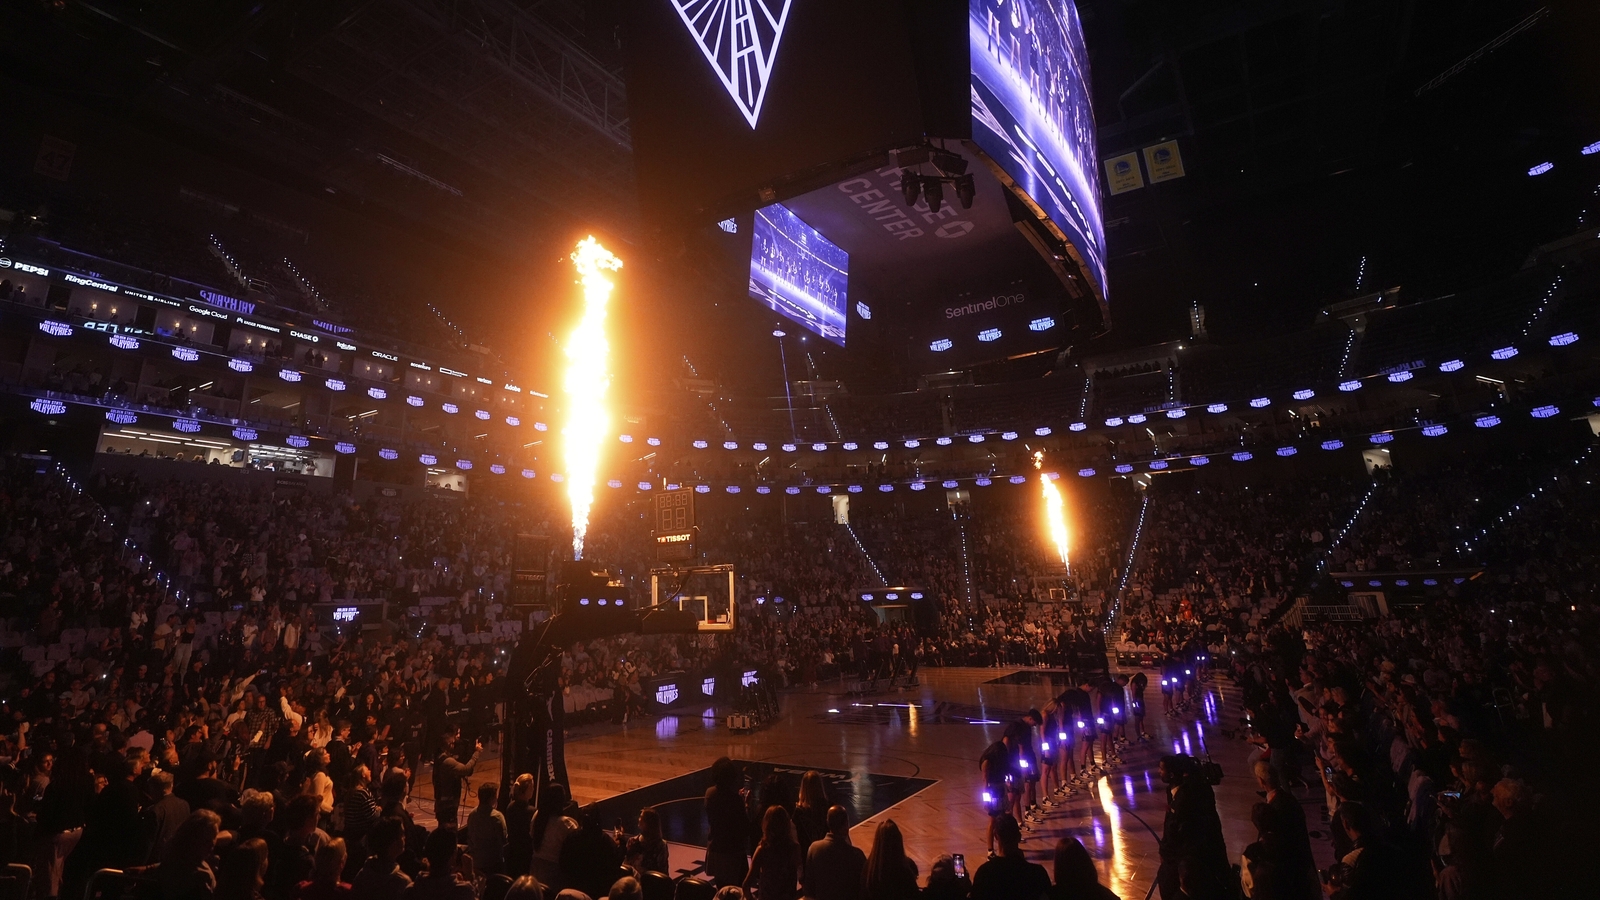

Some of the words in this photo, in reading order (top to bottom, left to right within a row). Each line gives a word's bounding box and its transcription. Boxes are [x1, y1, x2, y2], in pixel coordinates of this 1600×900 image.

[838, 178, 924, 240] CENTER
[14, 262, 49, 277] PEPSI
[65, 274, 118, 292] RingCentral
[125, 290, 147, 299] UNITED
[154, 297, 180, 307] AIRLINES
[189, 305, 210, 316] Google
[211, 311, 228, 319] Cloud
[945, 293, 1025, 319] SentinelOne
[39, 322, 73, 336] VALKYRIES
[290, 330, 312, 341] CHASE
[109, 337, 140, 350] VALKYRIES
[372, 351, 398, 362] ORACLE
[30, 401, 66, 415] VALKYRIES
[105, 412, 138, 424] VALKYRIES
[666, 534, 691, 543] TISSOT
